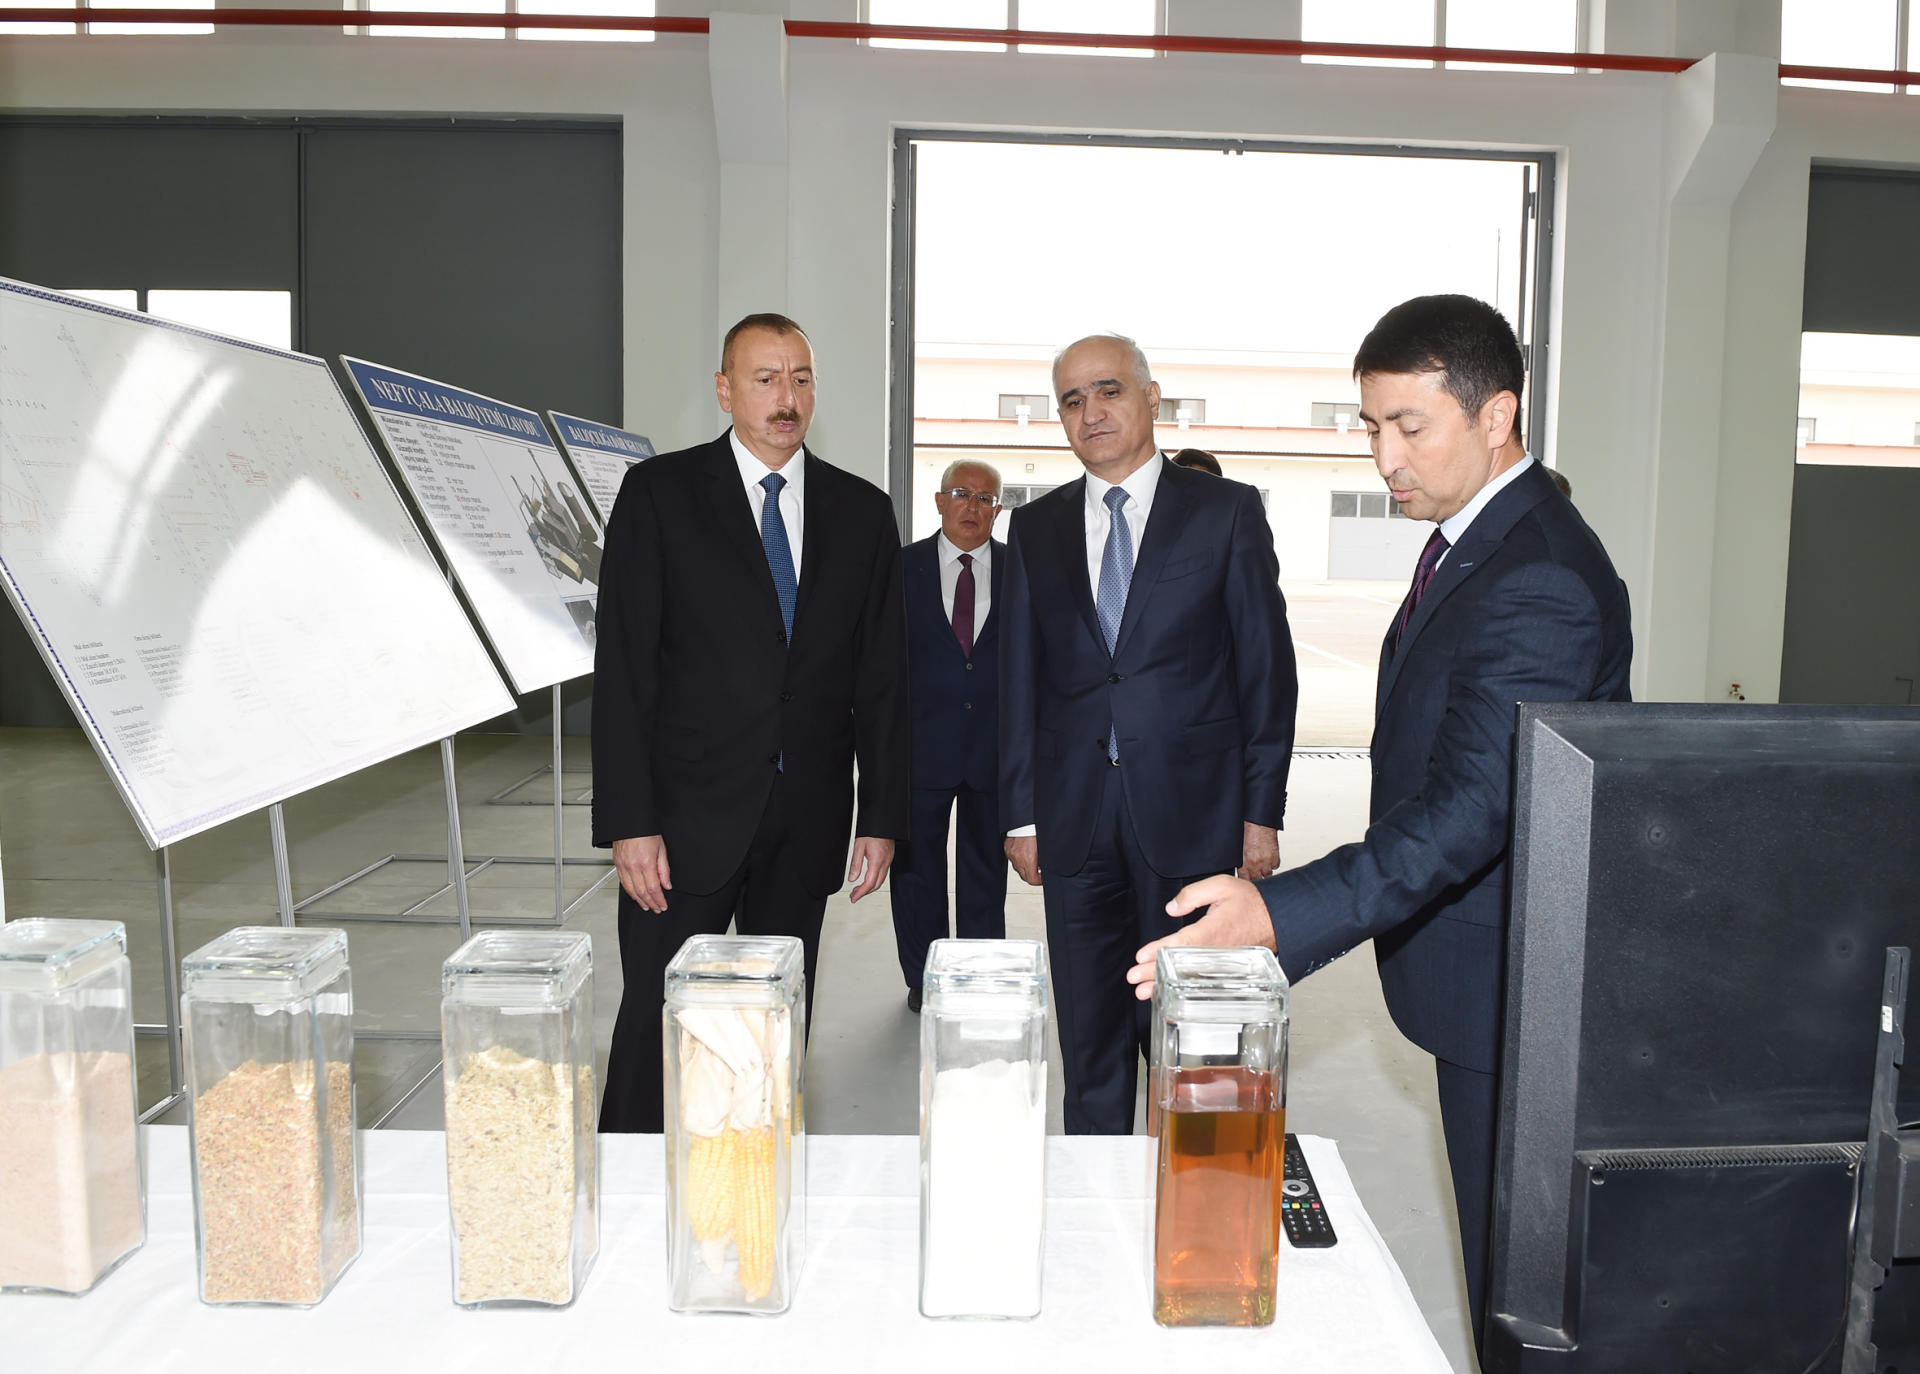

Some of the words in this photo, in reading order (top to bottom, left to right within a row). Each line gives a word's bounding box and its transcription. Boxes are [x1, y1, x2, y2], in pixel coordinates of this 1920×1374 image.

[370, 378, 446, 412] NEFTÇALA
[442, 396, 484, 426] BALIQ
[476, 406, 505, 428] YEMİ
[502, 413, 541, 437] ZAVODU
